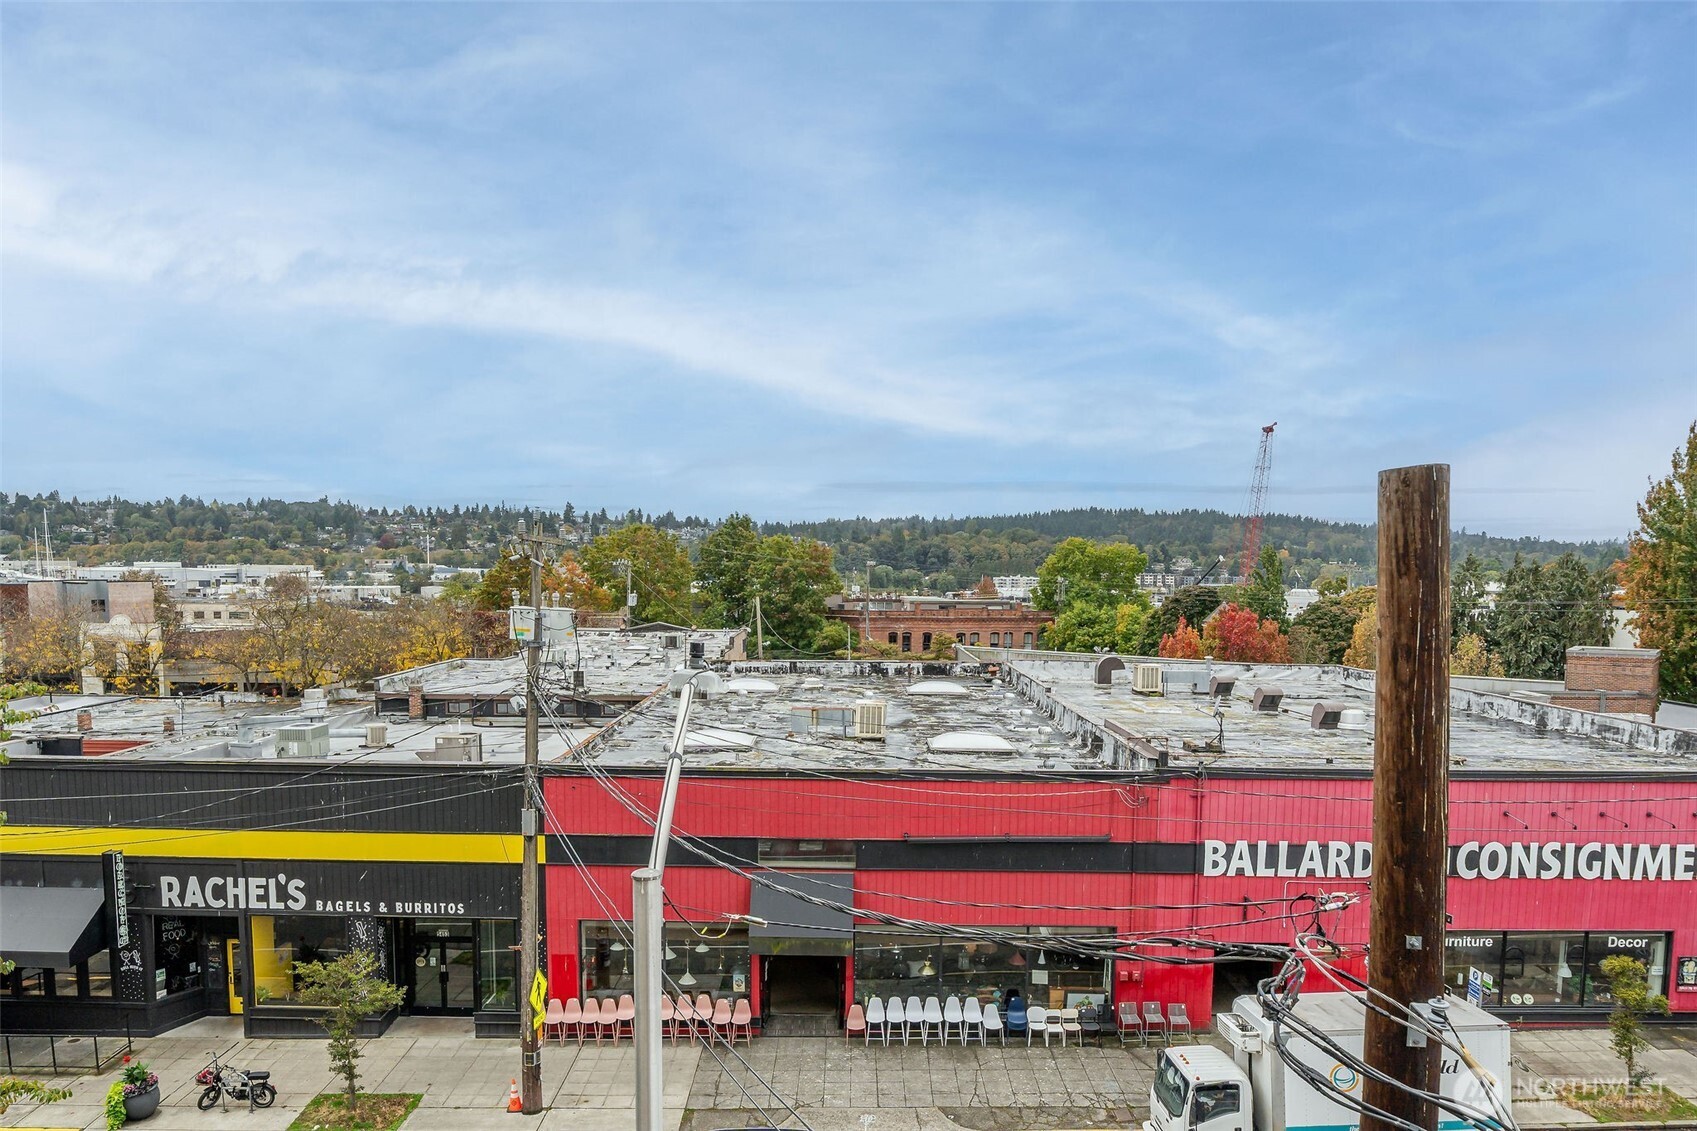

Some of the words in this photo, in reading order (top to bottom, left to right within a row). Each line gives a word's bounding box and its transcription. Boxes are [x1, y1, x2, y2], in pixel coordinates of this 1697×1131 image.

[1203, 839, 1373, 878] BALLARD
[1456, 841, 1697, 881] CONSIGNME
[160, 873, 306, 911] RACHEL'S
[315, 900, 371, 912] BAGELS
[379, 901, 388, 913] &
[395, 902, 465, 914] BURRITOS
[161, 920, 184, 931] REAL
[162, 928, 187, 941] FOOD
[1607, 936, 1649, 948] Decor
